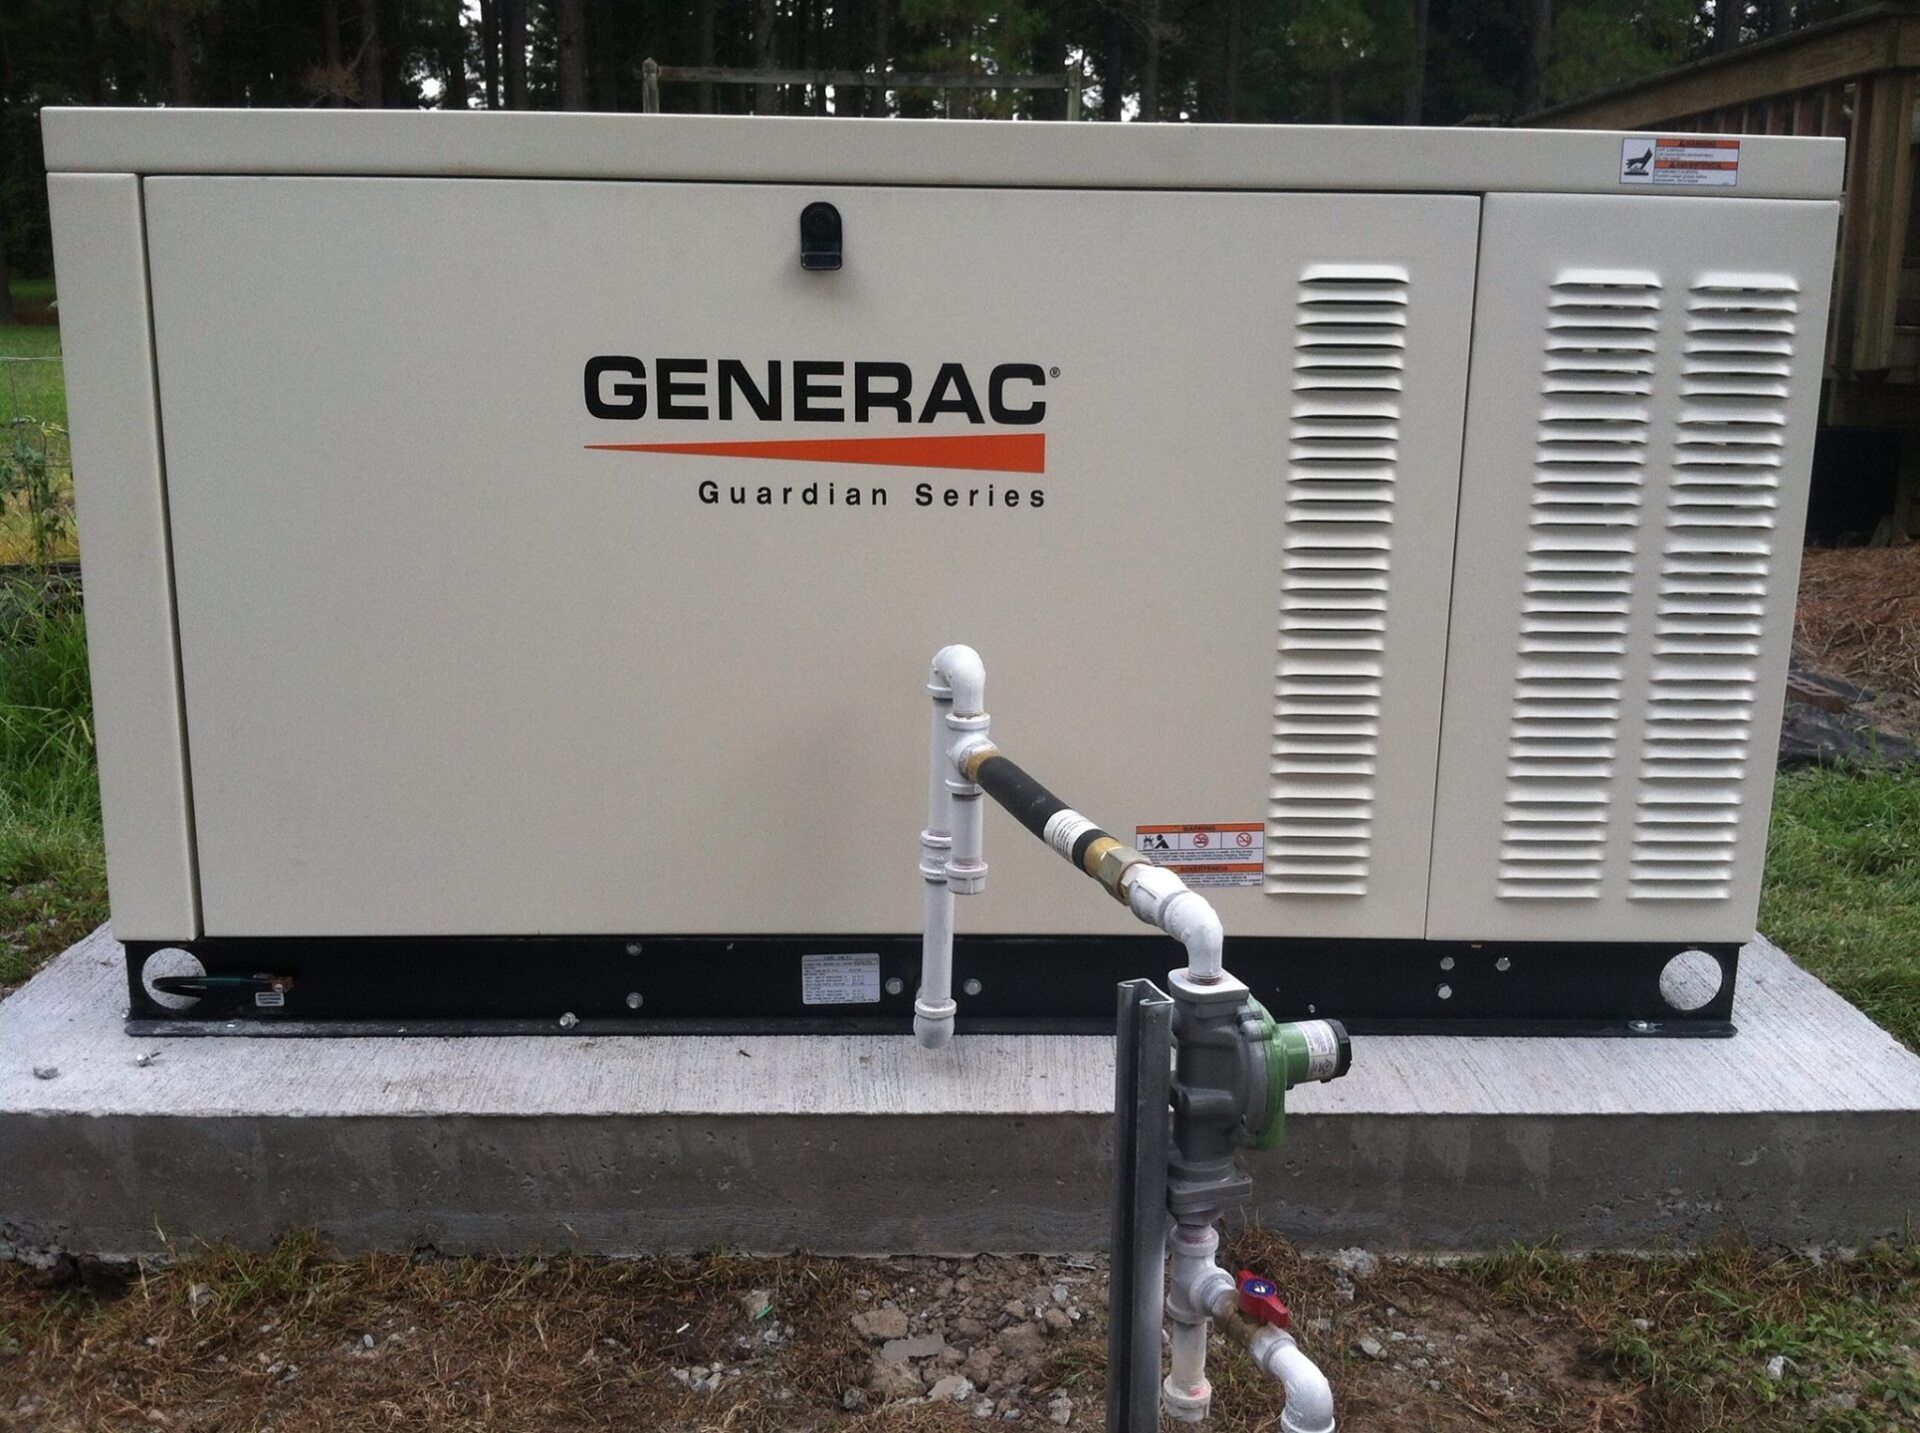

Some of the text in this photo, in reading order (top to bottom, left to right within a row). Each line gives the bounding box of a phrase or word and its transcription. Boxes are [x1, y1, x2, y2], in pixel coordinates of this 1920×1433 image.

[584, 355, 1046, 425] GENERAC
[698, 480, 1045, 507] Guardian Series
